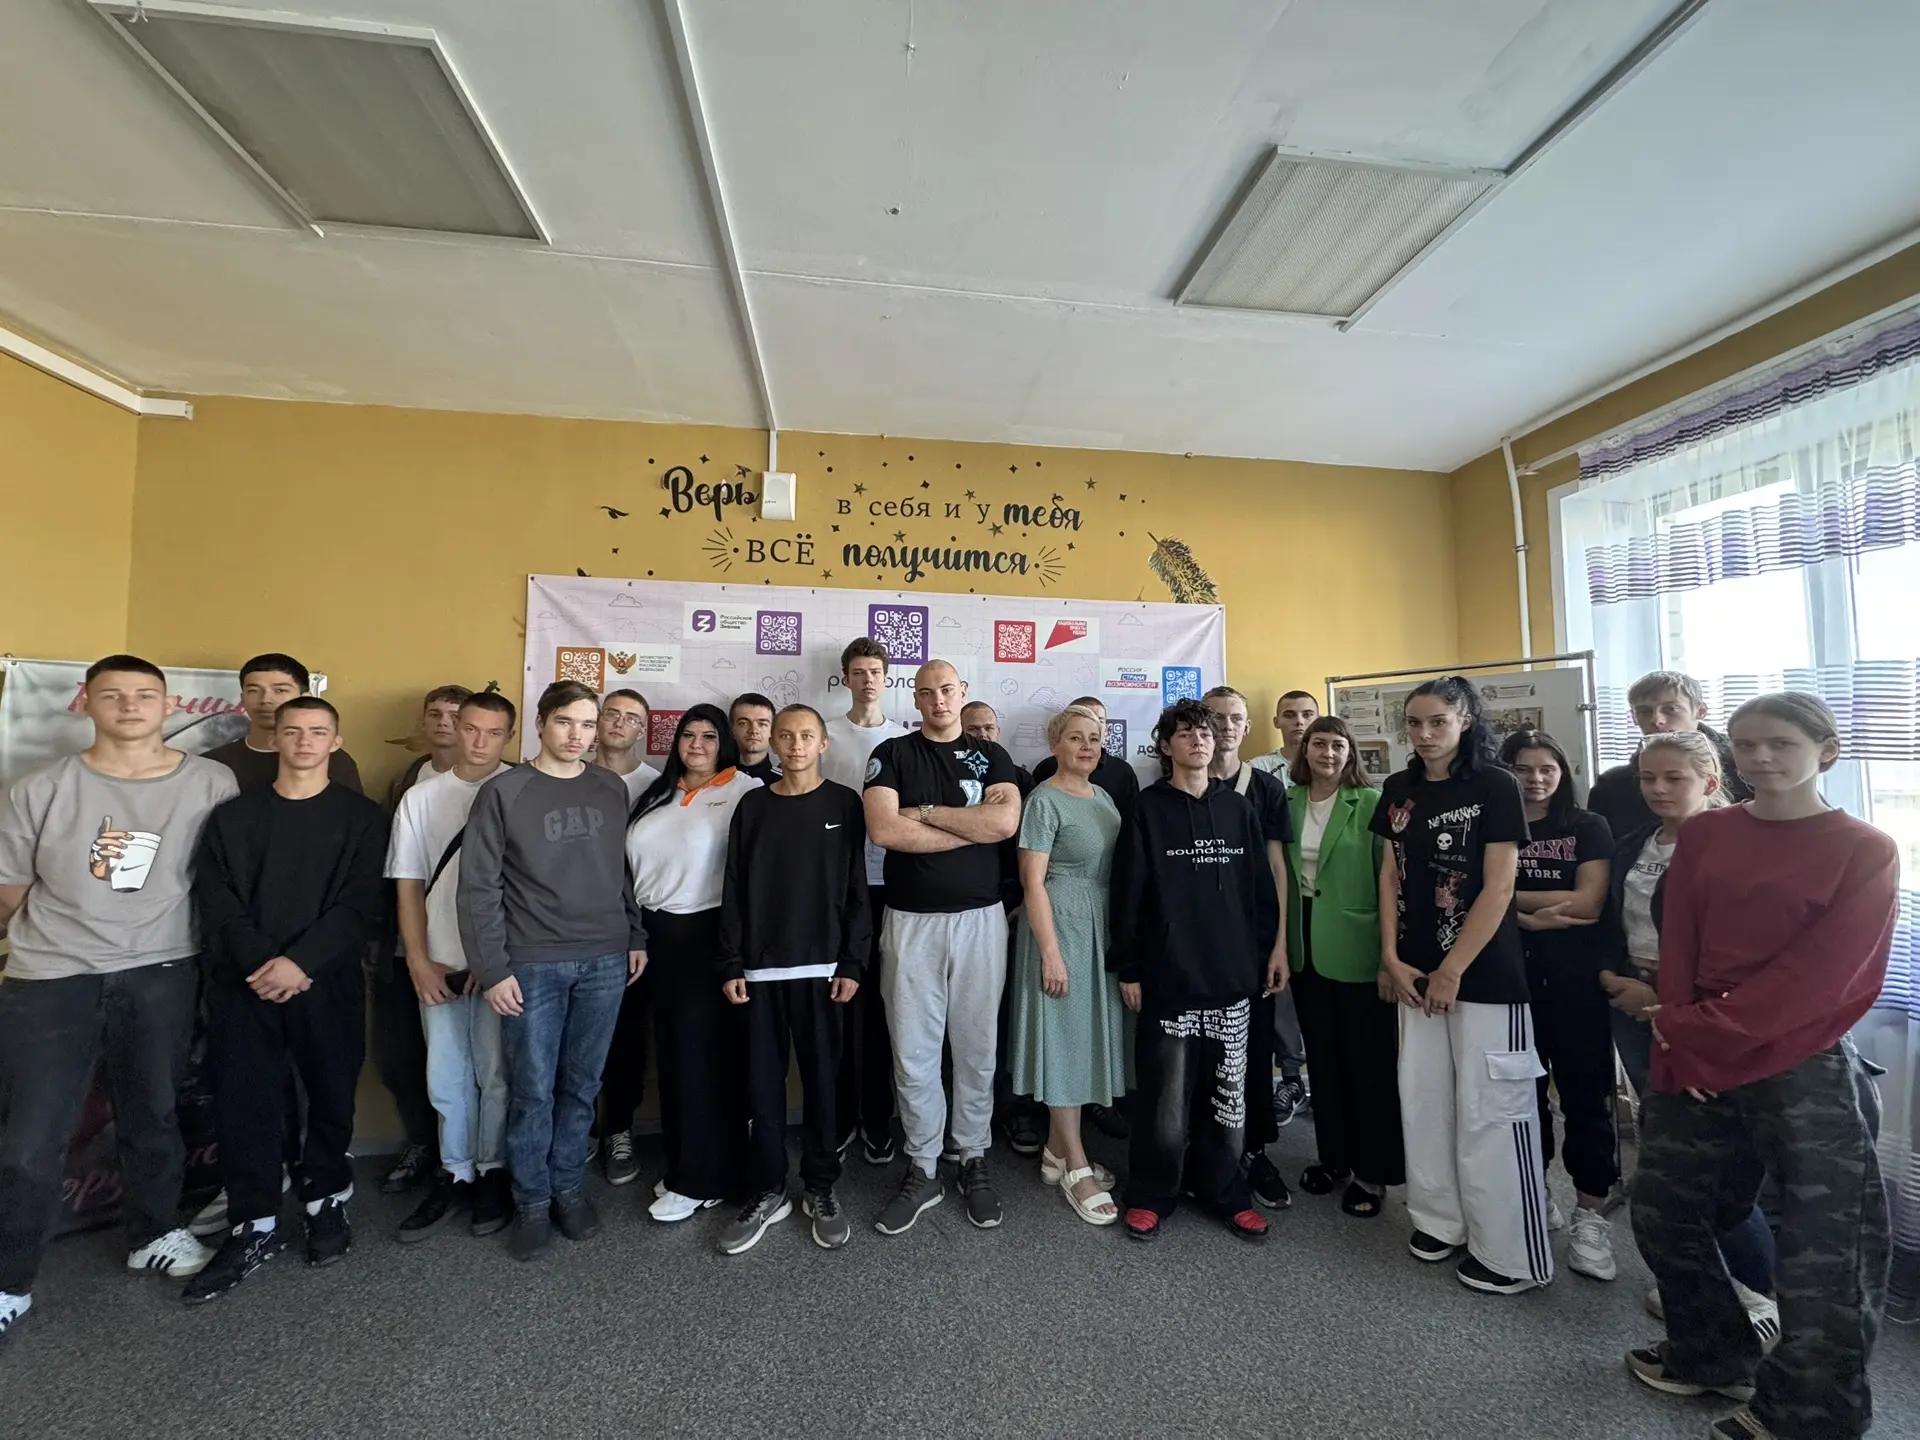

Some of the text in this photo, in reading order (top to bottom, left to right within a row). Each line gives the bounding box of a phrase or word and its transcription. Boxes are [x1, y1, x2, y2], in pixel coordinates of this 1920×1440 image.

[663, 466, 1083, 532] Верь в себя и у тебя
[745, 533, 1030, 583] ВСЁ получится
[544, 805, 605, 842] GAP
[1194, 839, 1225, 847] gym
[1525, 868, 1562, 880] YORK
